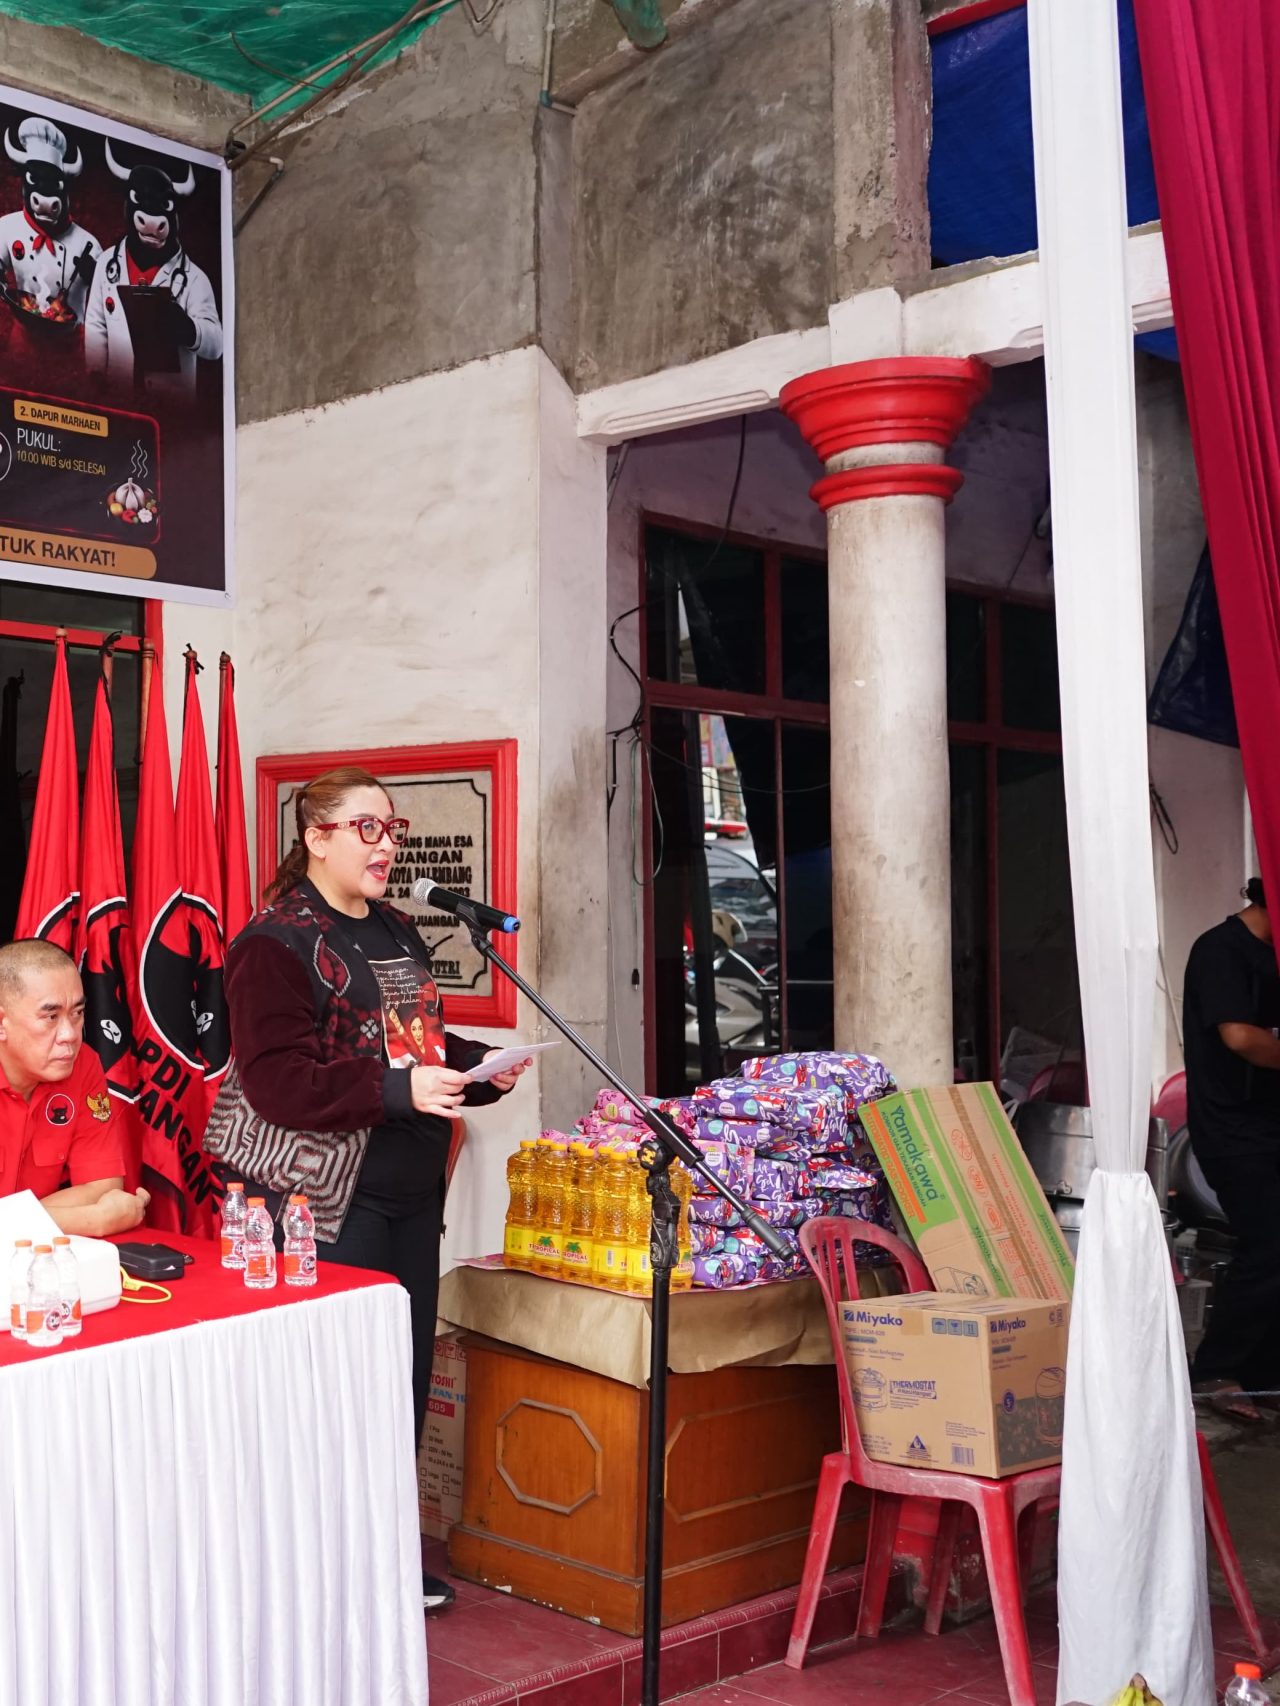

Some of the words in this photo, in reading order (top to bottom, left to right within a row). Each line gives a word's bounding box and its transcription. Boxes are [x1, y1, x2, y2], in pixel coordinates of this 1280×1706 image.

[20, 406, 29, 417] 2.
[31, 408, 59, 423] DAPUR
[61, 414, 101, 431] MARHAEN
[17, 428, 61, 452] PUKUL:
[16, 450, 39, 464] 10.00
[40, 454, 57, 467] WIB
[59, 457, 71, 470] s/d
[73, 461, 107, 476] SELESAI
[41, 541, 116, 569] RAKYAT!
[425, 836, 451, 848] MAHA
[454, 835, 473, 847] ESA
[395, 850, 463, 864] UANGAN
[411, 915, 460, 927] JUANGAN
[136, 1037, 193, 1101] PDI
[139, 1085, 213, 1207] ANGAN
[891, 1105, 938, 1201] Yamakawa
[857, 1311, 903, 1327] Miyako
[999, 1317, 1026, 1334] Miyako
[892, 1381, 936, 1391] THERMOSTAT
